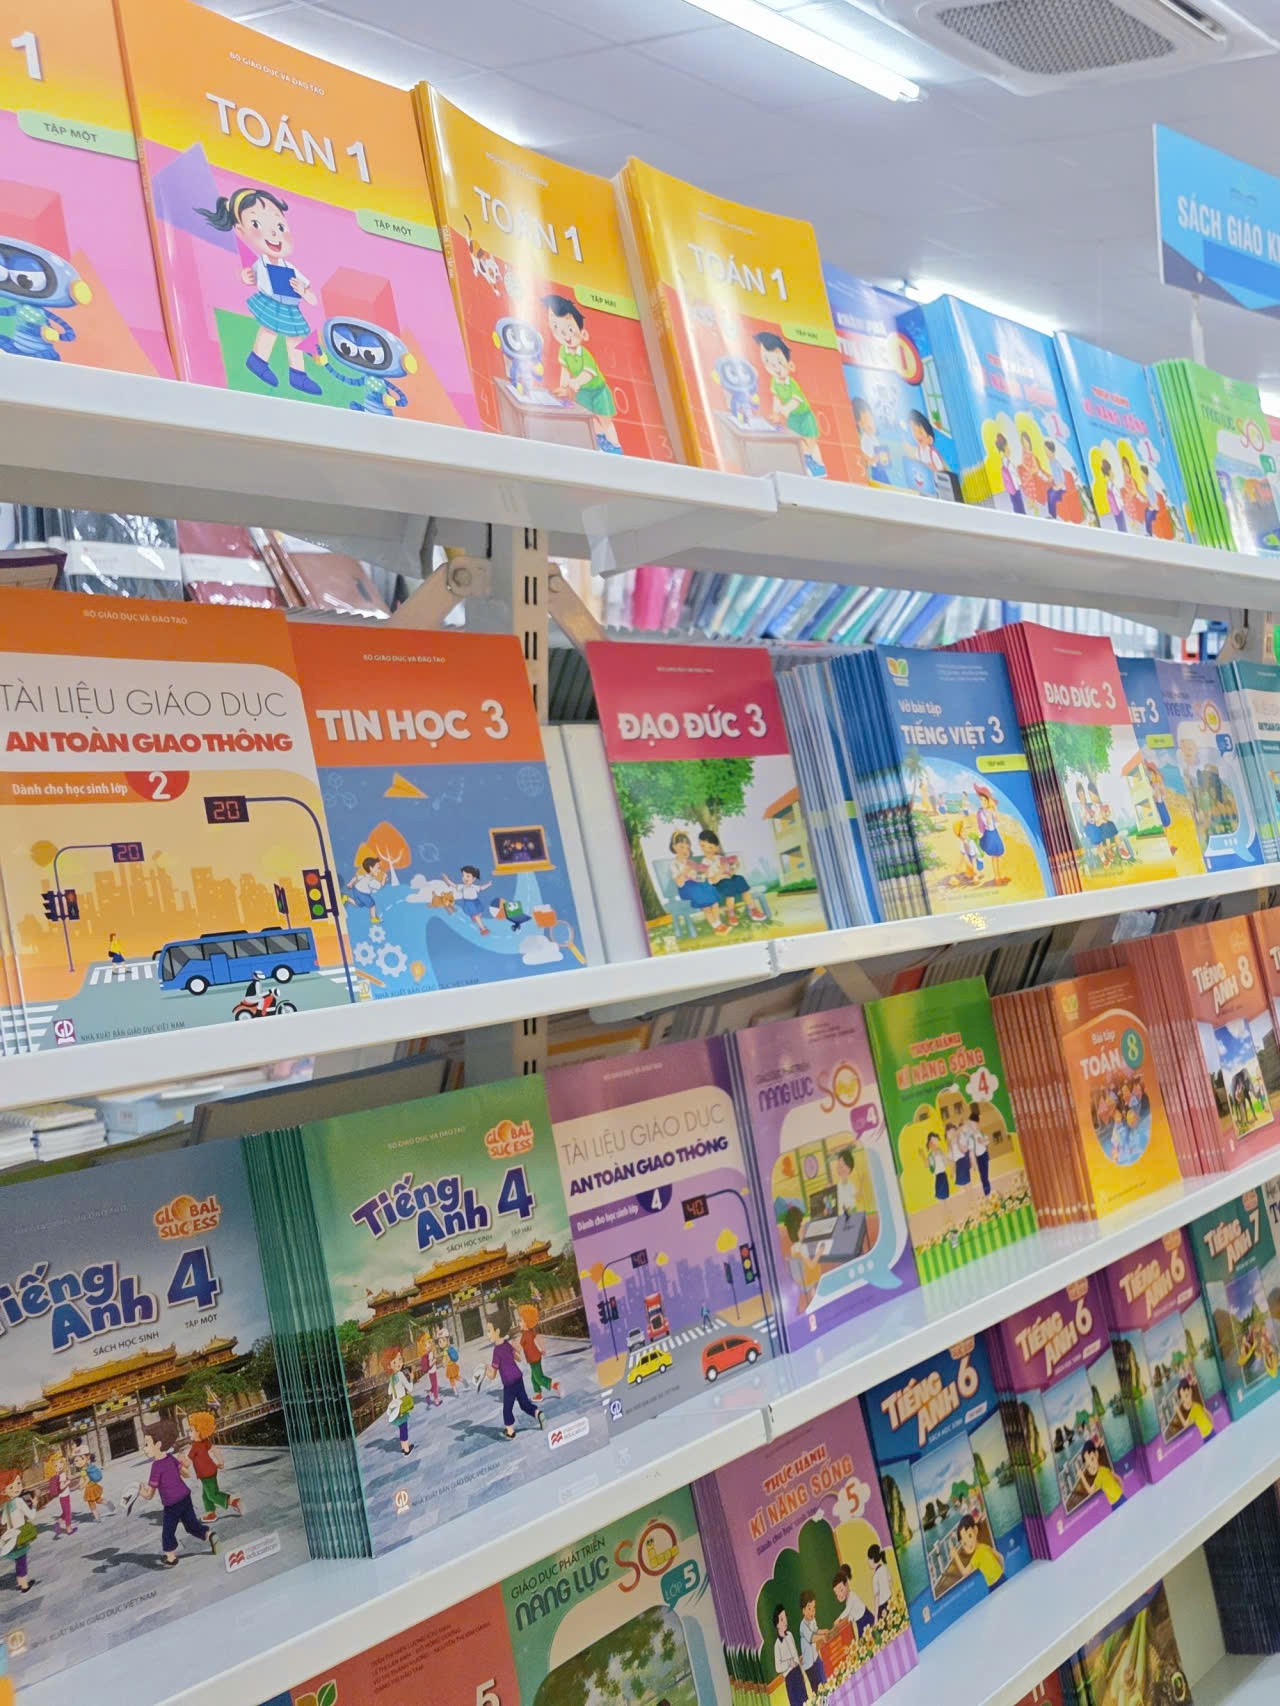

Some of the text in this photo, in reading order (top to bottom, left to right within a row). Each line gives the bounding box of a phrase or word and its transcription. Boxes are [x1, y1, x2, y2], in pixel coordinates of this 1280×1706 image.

[11, 31, 42, 81] 1
[43, 122, 98, 144] TẬP MỘT
[205, 92, 371, 184] TOÁN 1
[373, 218, 413, 238] TẬP MỘT
[565, 225, 584, 263] 1
[1177, 193, 1222, 241] SÁCH
[1227, 215, 1263, 257] GIÁO
[687, 242, 788, 301] TOÁN 1
[0, 678, 288, 722] TÀI LIỆU GIÁO DỤC
[1043, 681, 1117, 711] ĐẠO ĐỨC 3
[1146, 698, 1160, 723] 3
[6, 726, 294, 753] AN TOÀN GIAO THÔNG
[315, 699, 510, 748] TIN HỌC 3
[617, 703, 767, 747] ĐẠO ĐỨC 3
[901, 713, 1004, 749] TIẾNG VIỆT 3
[1223, 736, 1232, 750] 3
[12, 780, 129, 799] Dành cho học sinh lớp
[148, 771, 171, 800] 2
[212, 801, 241, 821] 20
[116, 843, 141, 862] 20
[1191, 956, 1227, 993] TIẾNG
[1213, 979, 1239, 1016] ANH
[1237, 955, 1253, 990] 8
[949, 1046, 989, 1095] SỐNG 4
[1080, 1034, 1139, 1081] TOÁN 8
[562, 1103, 725, 1167] TÀI LIỆU GIÁO DỤC
[866, 1105, 878, 1126] 4
[570, 1136, 729, 1197] AN TOÀN GIAO THÔNG
[352, 1172, 462, 1239] Tiếng
[416, 1165, 535, 1252] Anh 4
[651, 1188, 662, 1211] 4
[685, 1201, 704, 1216] 40
[446, 1239, 464, 1254] SÁCH
[464, 1236, 478, 1249] HỌC
[1204, 1218, 1243, 1259] TIẾNG
[1228, 1209, 1260, 1273] ANH 7
[0, 1261, 117, 1335] iếng
[52, 1246, 221, 1353] Anh 4
[1119, 1259, 1161, 1304] TIẾNG
[1146, 1256, 1185, 1320] ANH 6
[184, 1313, 218, 1329] TẬP MỘT
[1015, 1311, 1064, 1363] TIẾNG
[1044, 1320, 1078, 1378] ANH
[1074, 1298, 1093, 1335] 6
[93, 1331, 160, 1357] SÁCH HỌC SINH
[881, 1371, 943, 1432] TIẾNG
[918, 1381, 960, 1448] ANH
[957, 1355, 979, 1398] 6
[794, 1444, 828, 1474] HÀNH
[767, 1483, 809, 1526] NĂNG
[811, 1455, 855, 1496] SỐNG
[845, 1482, 859, 1514] 5
[510, 1535, 607, 1600] GIÁO DỤC PHÁT TRIỂN
[683, 1566, 698, 1590] 5
[514, 1554, 611, 1632] NĂNG LỰC
[476, 1678, 497, 1706] 5
